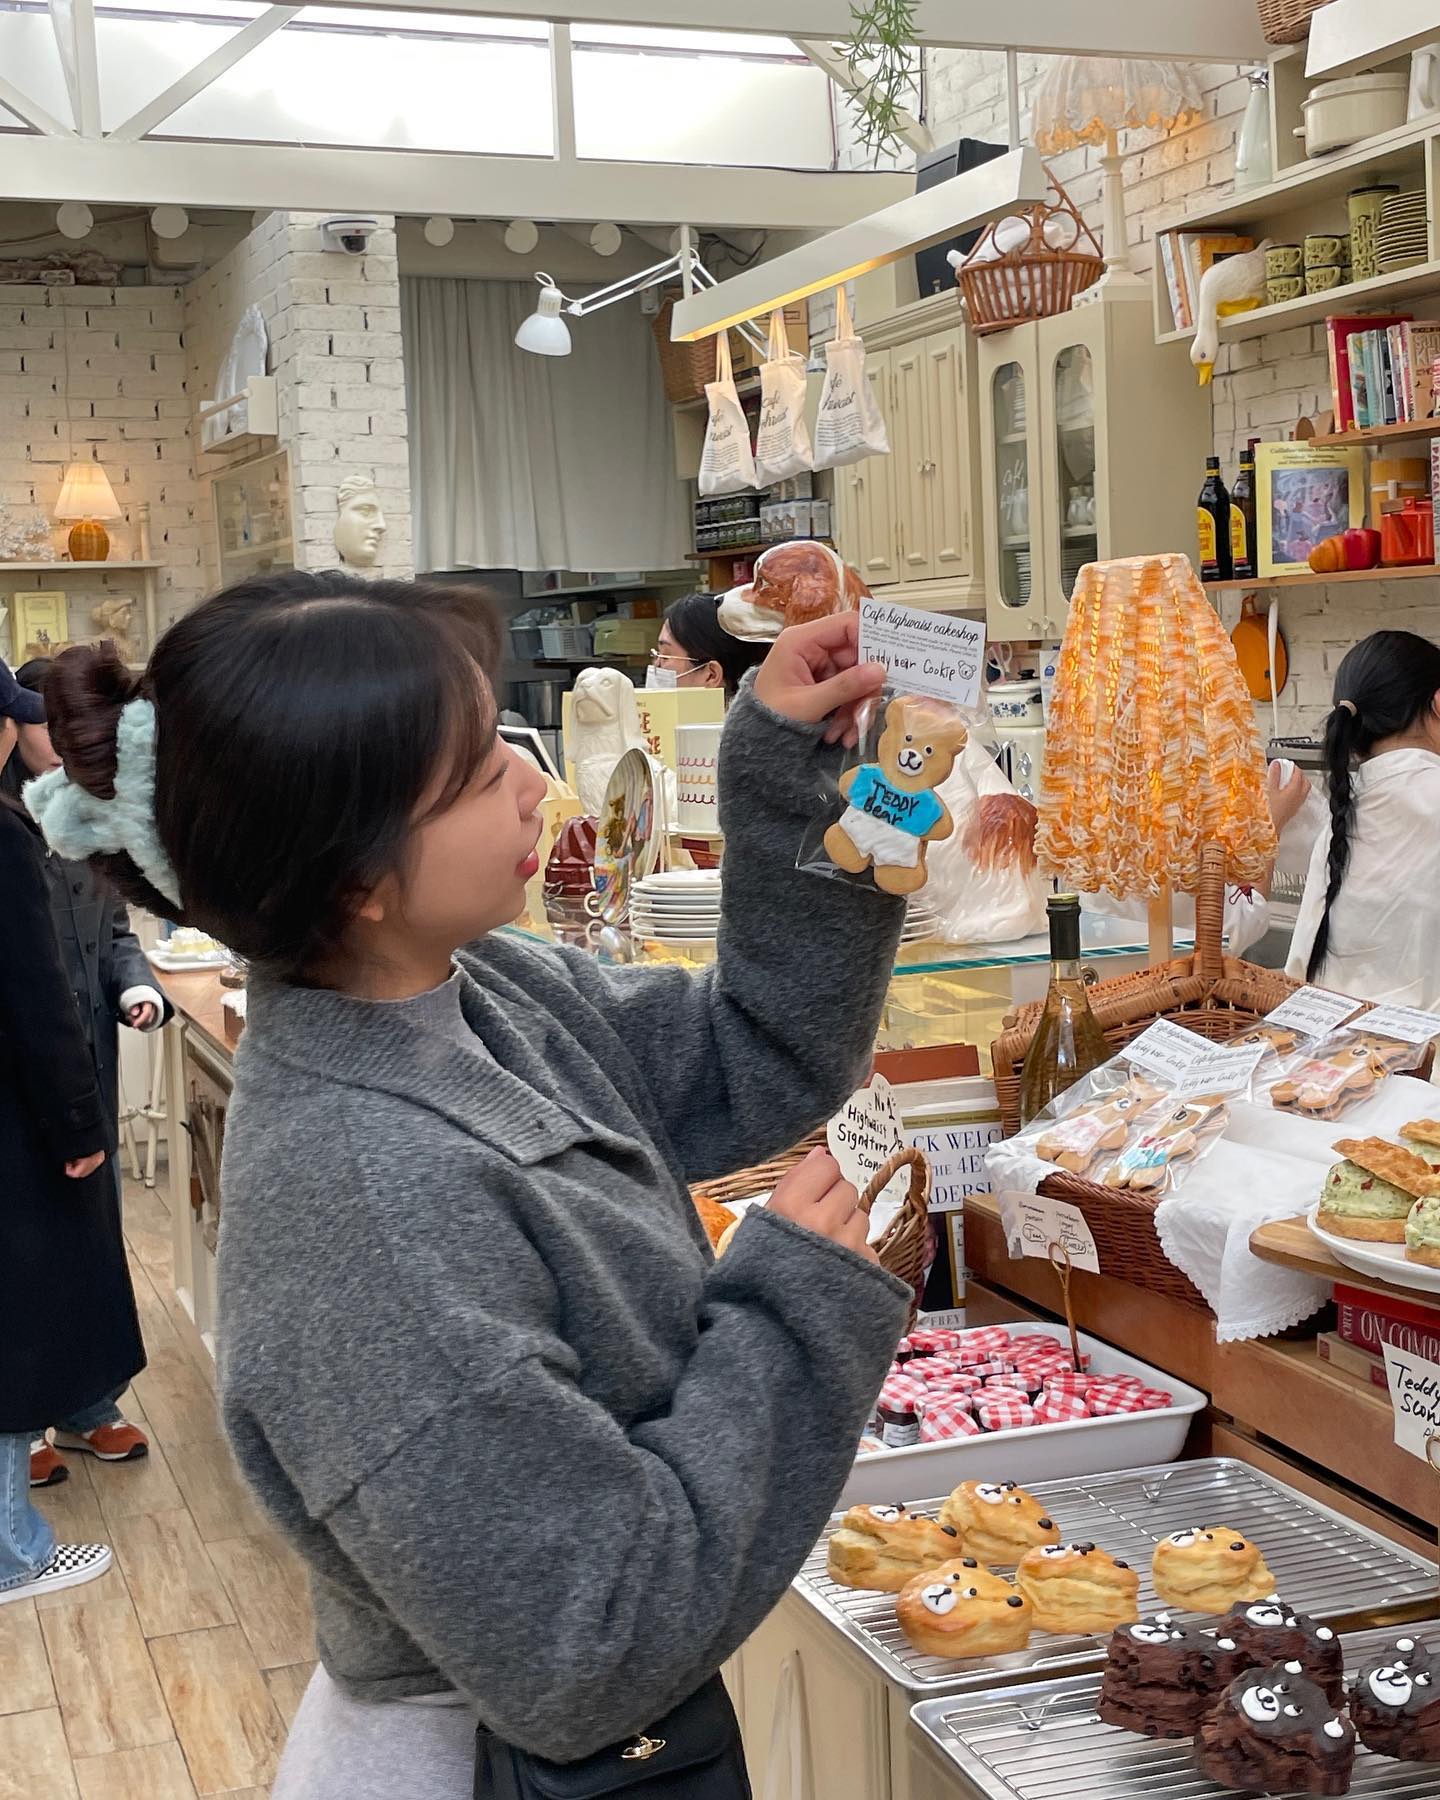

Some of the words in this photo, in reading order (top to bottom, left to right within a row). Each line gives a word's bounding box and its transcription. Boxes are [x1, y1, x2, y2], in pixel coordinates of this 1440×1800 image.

[885, 607, 933, 633] highwaist
[933, 622, 979, 646] cakeshop
[894, 653, 917, 670] bear
[923, 658, 956, 681] Cookie
[872, 779, 920, 817] TEDDY
[931, 1164, 952, 1176] HE
[1389, 1322, 1440, 1362] COMP
[1391, 1361, 1440, 1411] Teddy
[1400, 1393, 1440, 1426] Scon
